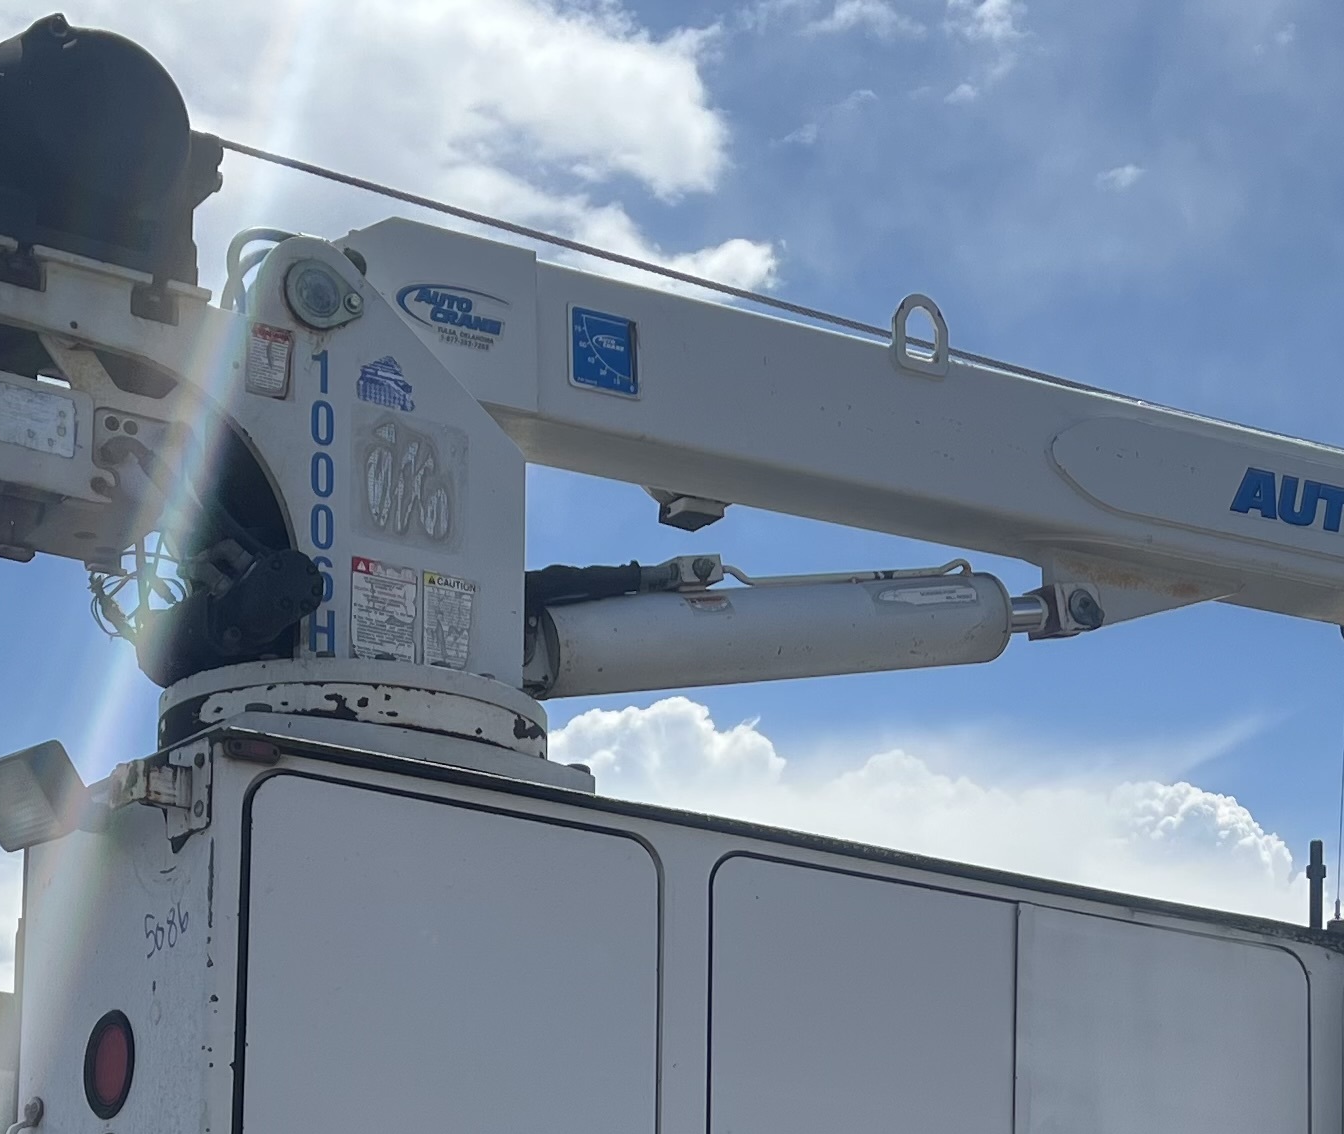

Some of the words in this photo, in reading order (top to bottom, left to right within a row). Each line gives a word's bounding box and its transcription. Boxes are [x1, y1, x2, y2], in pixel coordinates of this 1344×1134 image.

[414, 287, 473, 314] AUTO
[430, 306, 502, 336] CRANE
[436, 576, 476, 592] CAUTION
[144, 901, 189, 959] 5086
